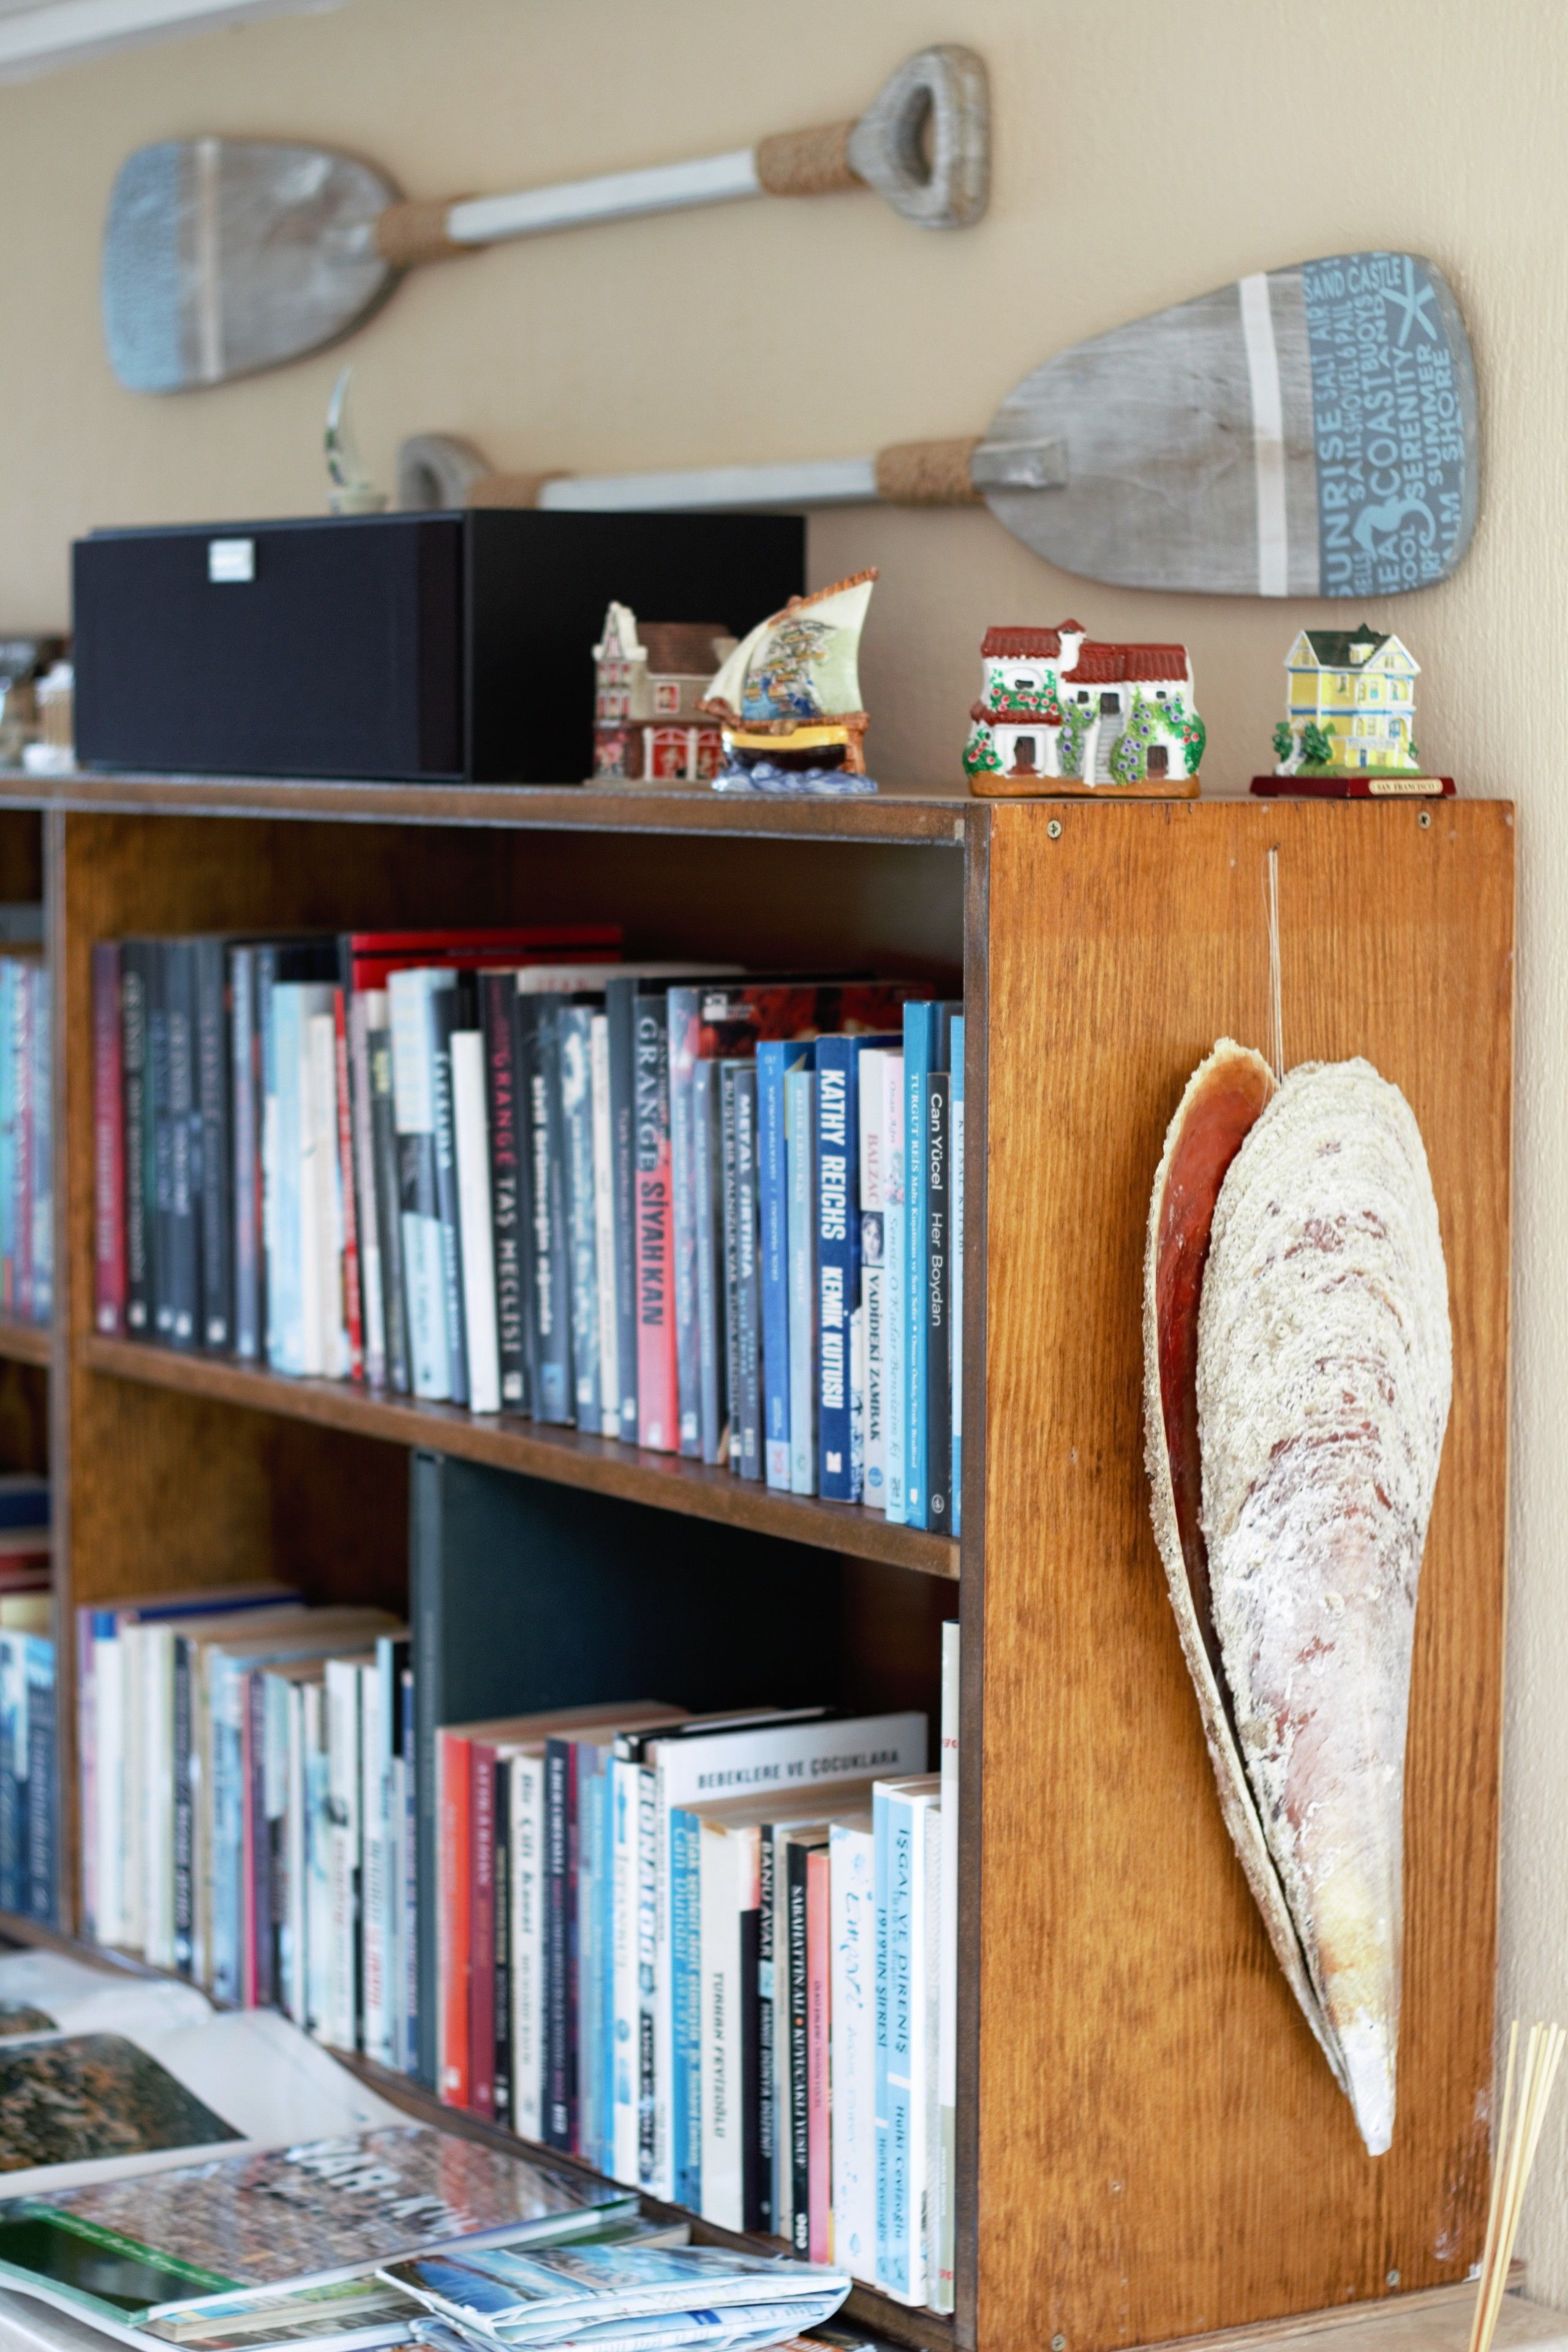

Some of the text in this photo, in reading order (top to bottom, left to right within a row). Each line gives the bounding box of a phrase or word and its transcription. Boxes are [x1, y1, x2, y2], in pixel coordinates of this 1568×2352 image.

[1304, 257, 1402, 303] SAND CASTLE
[1307, 306, 1338, 402] SALT AIR
[1331, 301, 1355, 344] PAIL
[1354, 293, 1378, 372] BUOYS
[1338, 360, 1364, 433] SHOVEL
[1392, 346, 1426, 500] SERENITY
[1415, 342, 1444, 486] SUMMER
[1432, 348, 1460, 462] SHORE
[1345, 434, 1366, 502] SAIL
[1362, 375, 1402, 497] COAST
[910, 1072, 919, 1137] TURGUT
[739, 1094, 753, 1280] METAL FIRTINA
[910, 1140, 921, 1172] REİS
[820, 1069, 849, 1409] KATHY REICHS KEMİK KUTUSU
[929, 1093, 944, 1327] Can Yücel Her Boydan
[641, 1182, 668, 1326] SİYAH KAN
[867, 1133, 883, 1442] BALZAC VADİDEKİ ZAMBAK
[696, 1749, 900, 1790] BEBEKLERE VE ÇOCUKLARA
[761, 1841, 774, 1902] BANU
[896, 1829, 910, 1898] İŞGAL
[760, 1903, 774, 1958] AVAR
[898, 1913, 908, 1942] VE
[713, 1972, 725, 2040] TURHAN
[791, 1885, 807, 2168] SABAHATTİN ALİ KUYUCAKLI YUSUF
[895, 1954, 910, 2054] DİRENİŞ
[878, 2138, 888, 2173] Hulki
[895, 2105, 905, 2149] Hulki
